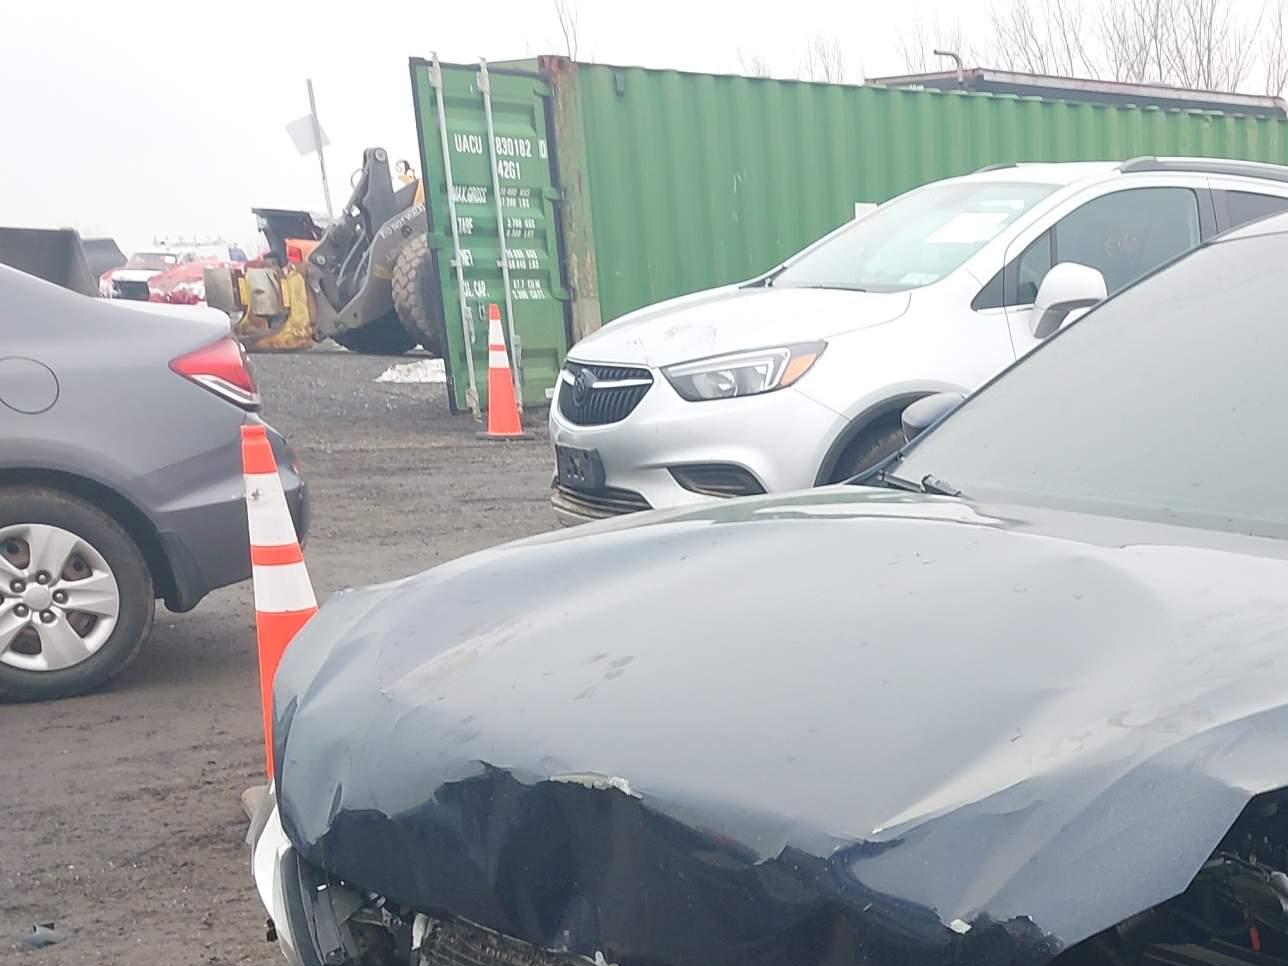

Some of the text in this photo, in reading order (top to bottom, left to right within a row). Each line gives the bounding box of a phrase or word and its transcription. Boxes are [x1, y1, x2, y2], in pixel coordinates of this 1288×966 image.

[454, 133, 483, 154] UACU
[495, 136, 532, 157] 830182
[497, 160, 521, 180] 42G1
